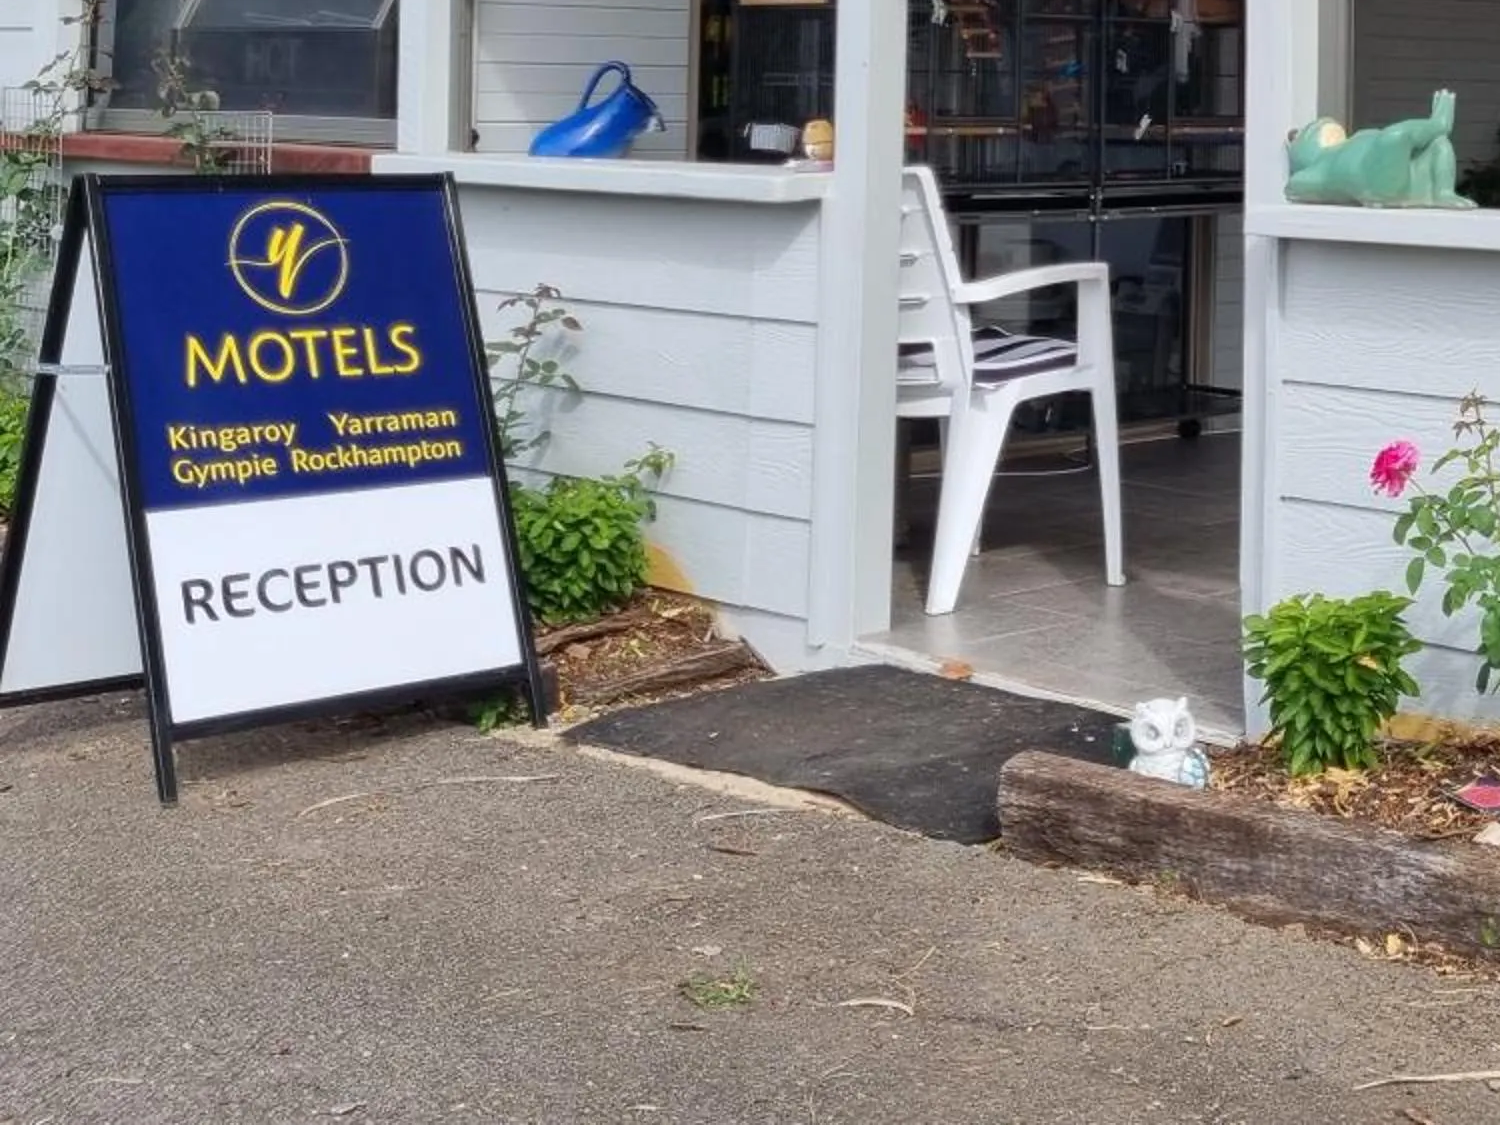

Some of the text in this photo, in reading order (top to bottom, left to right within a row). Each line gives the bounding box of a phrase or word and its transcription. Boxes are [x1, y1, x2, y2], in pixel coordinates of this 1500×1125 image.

[186, 324, 421, 387] MOTELS
[168, 410, 456, 452] Kingaroy Yarraman
[172, 439, 462, 489] Gympie Rockhampton
[181, 544, 485, 624] RECEPTION
